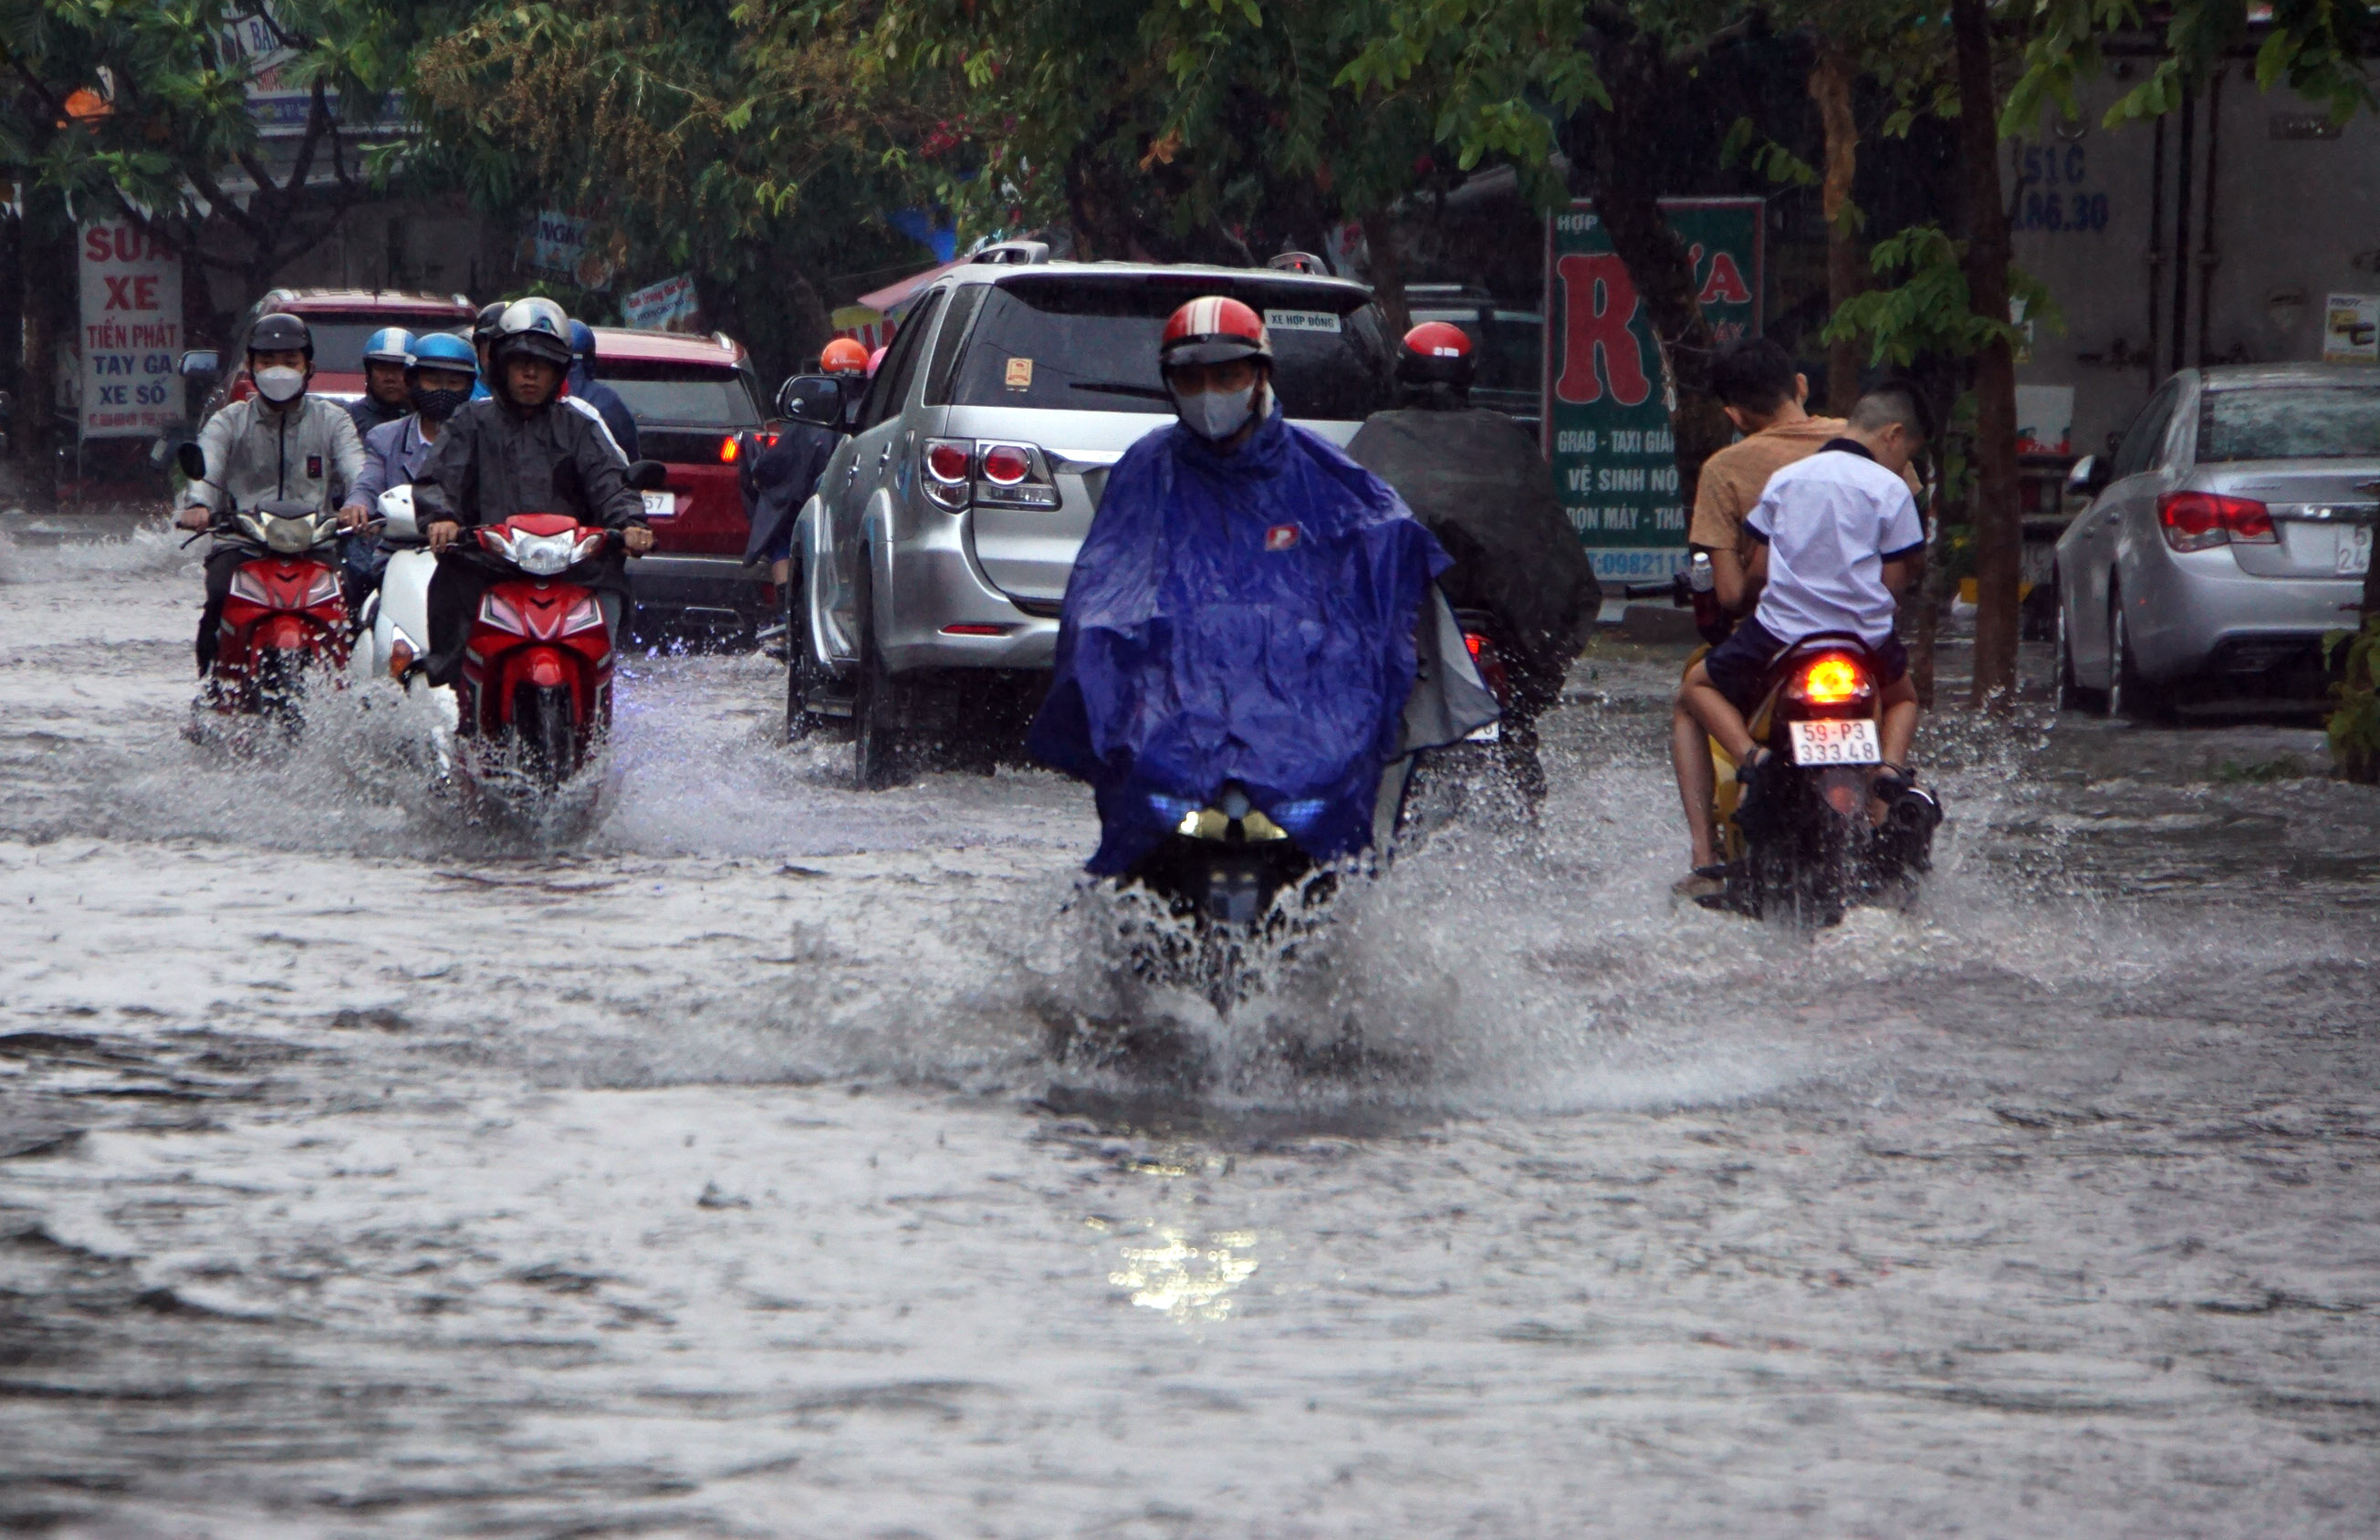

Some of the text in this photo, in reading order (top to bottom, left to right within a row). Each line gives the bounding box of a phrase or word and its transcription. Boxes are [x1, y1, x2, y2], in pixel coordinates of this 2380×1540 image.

[104, 276, 159, 310] XE
[1271, 314, 1284, 325] XE
[93, 354, 172, 376] TAY GA
[99, 385, 128, 405] XE
[1557, 430, 1596, 453] GRAB
[1611, 430, 1642, 453] TAXI
[1568, 463, 1592, 496] VỆ
[1598, 468, 1644, 492] SINH
[1602, 503, 1639, 530] MÁY
